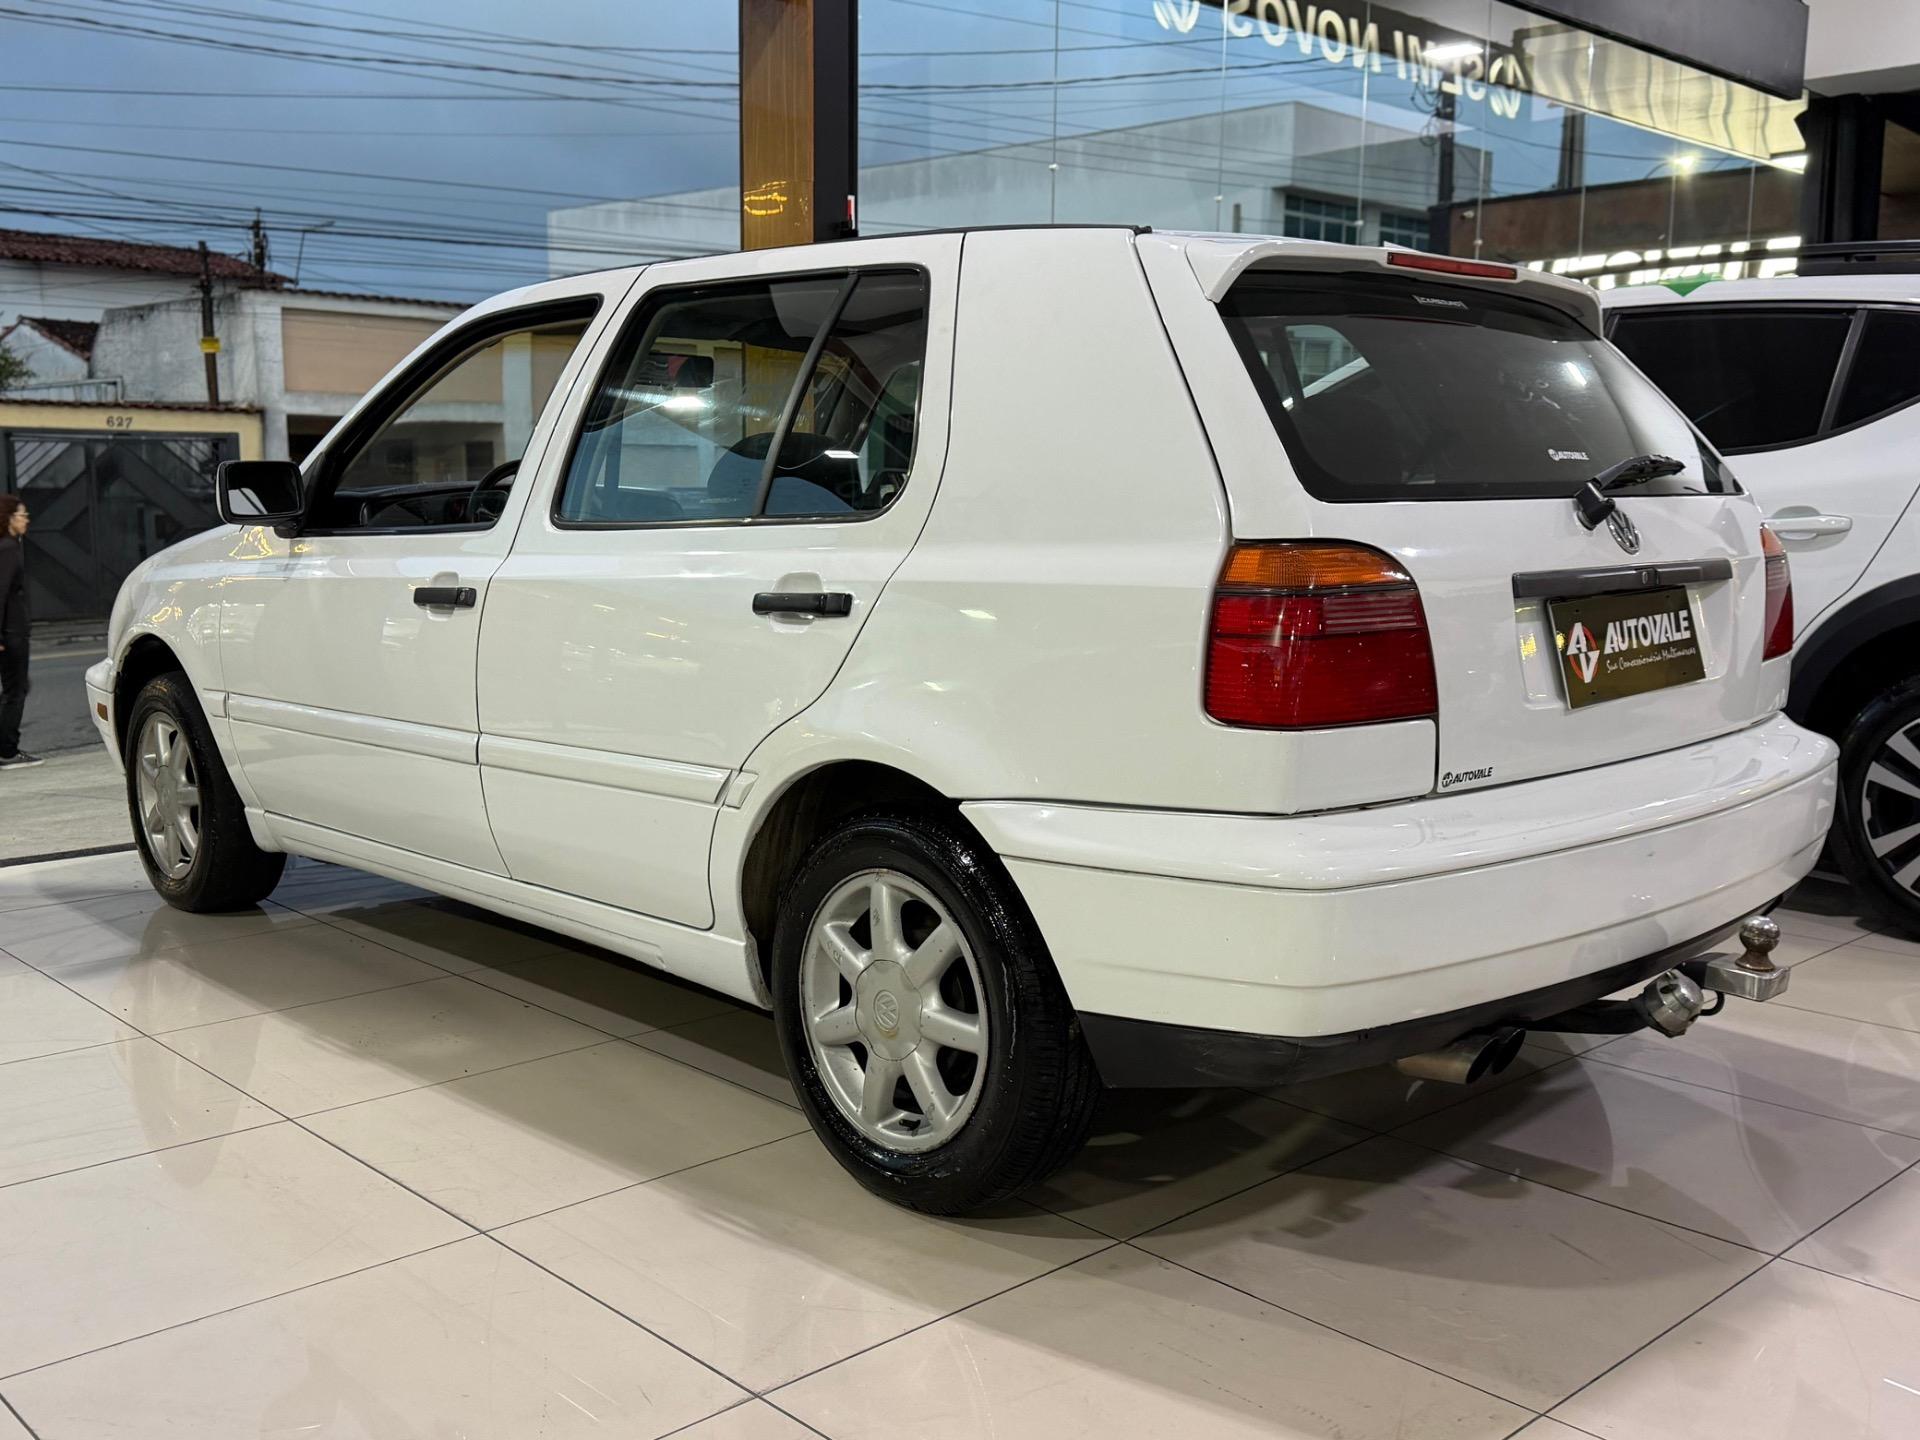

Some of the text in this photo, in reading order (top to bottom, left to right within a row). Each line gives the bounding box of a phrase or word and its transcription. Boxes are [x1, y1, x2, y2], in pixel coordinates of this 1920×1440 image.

[106, 415, 134, 429] 627
[1603, 609, 1692, 655] AUTOVALE
[1452, 766, 1494, 784] AUTOVALE
